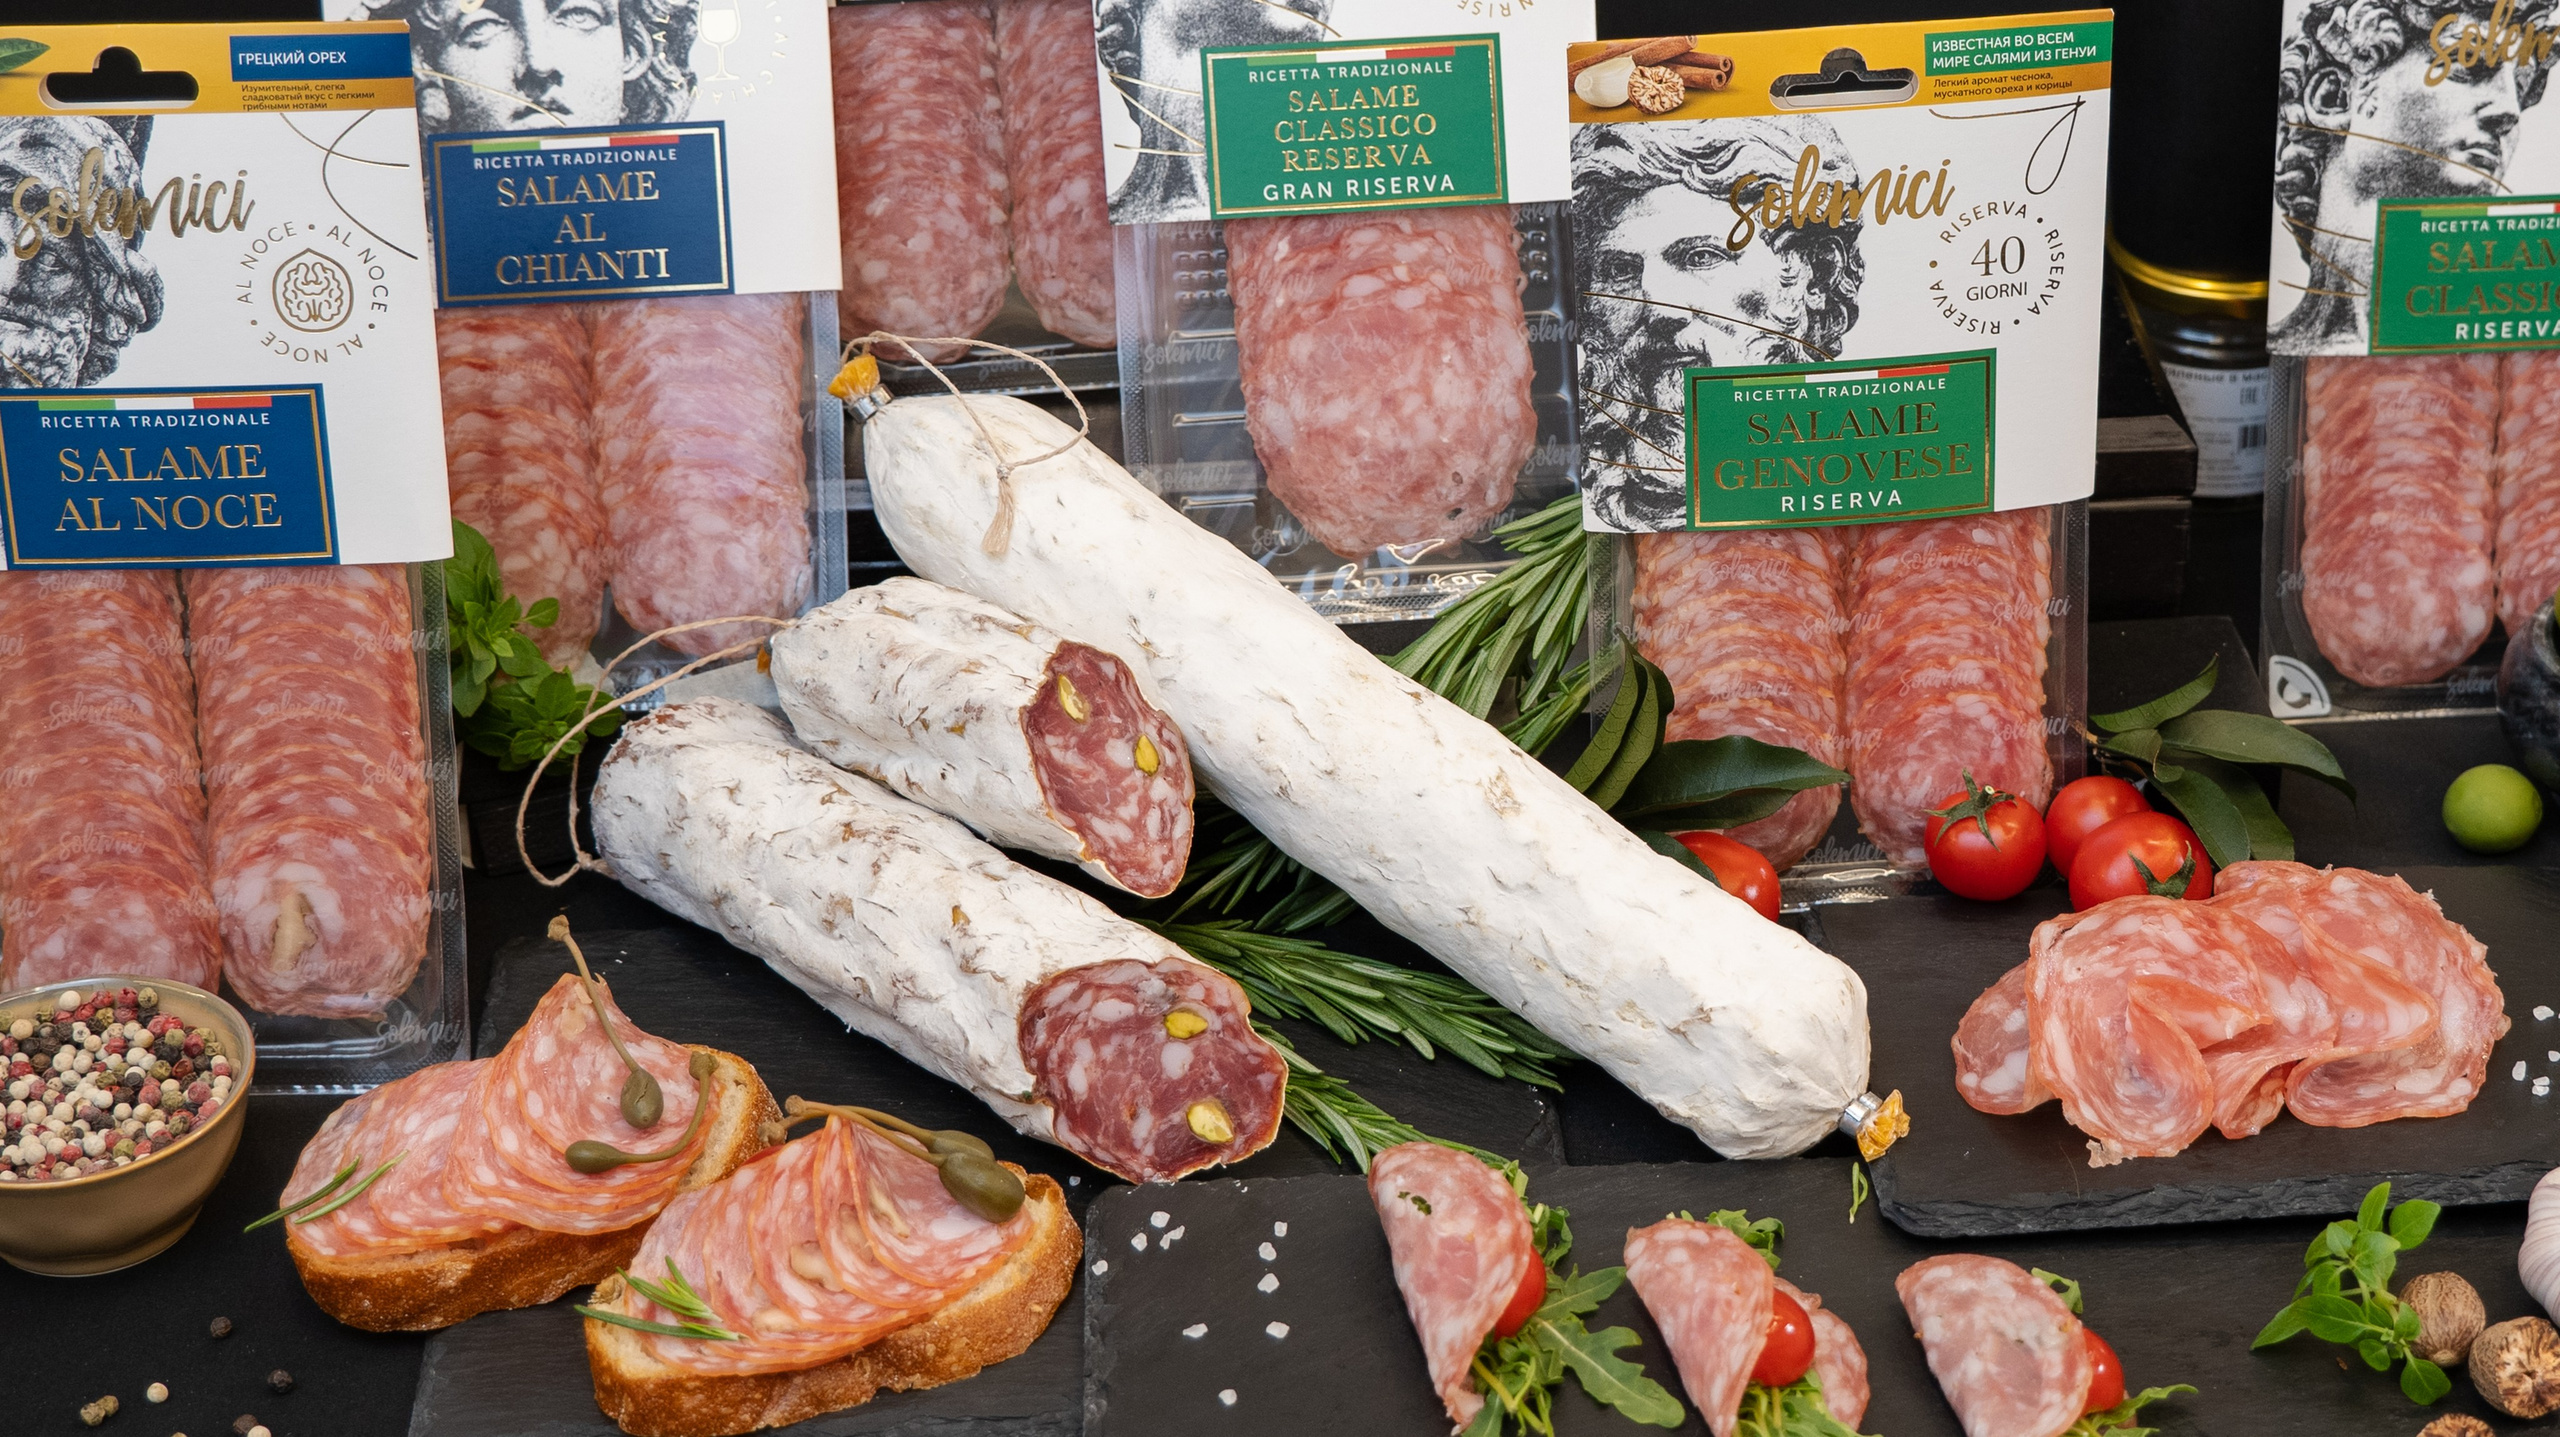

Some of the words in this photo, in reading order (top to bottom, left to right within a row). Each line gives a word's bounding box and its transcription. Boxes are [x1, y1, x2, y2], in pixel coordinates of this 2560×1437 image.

[1932, 36, 2010, 53] ИЗВЕСТНАЯ
[2014, 34, 2034, 48] ВО
[2037, 32, 2074, 45] ВСЕМ
[238, 50, 305, 66] ГРЕЦКИЙ
[308, 51, 347, 64] ОРЕХ
[1933, 57, 1970, 69] МИРЕ
[1973, 52, 2031, 66] САЛЯМИ
[2034, 50, 2051, 62] ИЗ
[2055, 45, 2097, 60] ГЕНУИ
[1248, 68, 1321, 84] RICETTA
[1327, 60, 1453, 80] TRADIZIONALE
[1934, 77, 1969, 88] Легкий
[1971, 75, 2008, 87] аромат
[2010, 72, 2053, 83] чеснока,
[241, 83, 312, 94] Изумительный,
[314, 83, 346, 92] слегка
[242, 93, 303, 102] сладковатый
[335, 92, 375, 100] легкими
[1288, 84, 1421, 113] SALAME
[1934, 87, 1993, 99] мускатного
[1994, 85, 2024, 96] ореха
[2035, 80, 2073, 91] корицы
[243, 101, 291, 112] грибными
[1274, 112, 1438, 144] CLASSICO
[473, 154, 545, 170] RICETTA
[551, 149, 677, 167] TRADIZIONALE
[1281, 143, 1433, 173] RESERVA
[497, 171, 660, 207] SALAME
[1262, 180, 1333, 201] GRAN
[1346, 174, 1455, 197] RISERVA
[553, 213, 606, 244] AL
[1940, 201, 2027, 243] RISERVA
[2420, 220, 2490, 233] RICETTA
[240, 220, 297, 270] NOCE
[1971, 236, 2025, 277] 40
[326, 225, 351, 247] AL
[358, 248, 389, 312] NOCE
[495, 248, 671, 285] CHIANTI
[2027, 229, 2065, 315] RISERVA
[238, 280, 253, 304] AL
[1966, 281, 2027, 301] GIORNI
[1929, 280, 2000, 334] RISERVA
[261, 332, 328, 364] NOCE
[337, 333, 363, 356] AL
[1734, 388, 1808, 403] RICETTA
[1816, 378, 1947, 398] TRADIZIONALE
[41, 416, 121, 428] RICETTA
[129, 413, 271, 427] TRADIZIONALE
[1747, 401, 1940, 445] SALAME
[58, 444, 267, 482] SALAME
[1713, 442, 1973, 490] GENOVESE
[54, 498, 121, 531] AL
[130, 493, 282, 530] NOCE
[1781, 489, 1903, 513] RISERVA
